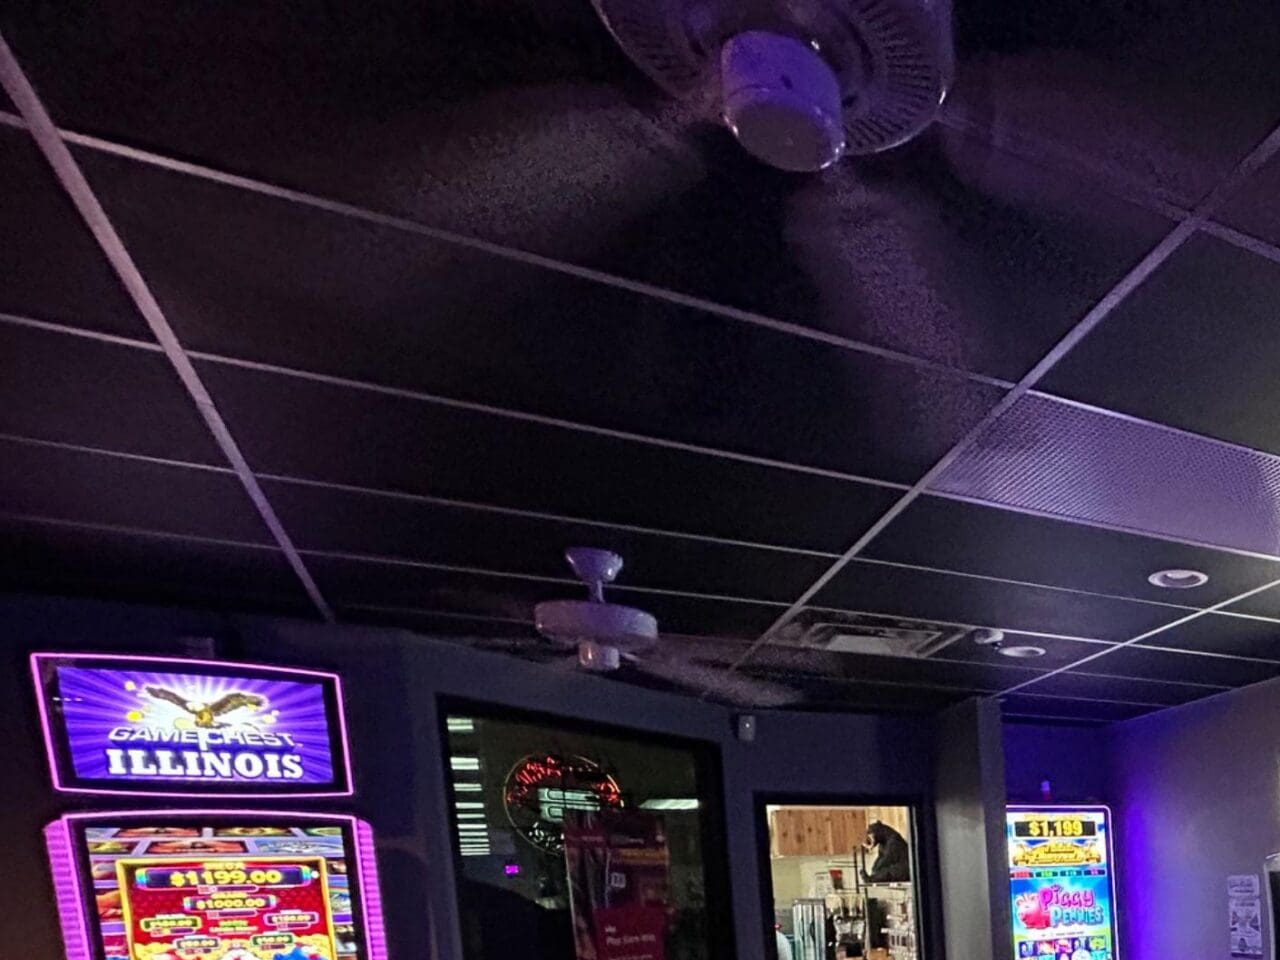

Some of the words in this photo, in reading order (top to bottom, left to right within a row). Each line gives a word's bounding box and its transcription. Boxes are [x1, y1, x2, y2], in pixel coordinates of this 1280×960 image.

[106, 748, 304, 780] ILLINOIS
[1028, 820, 1083, 837] $1,199
[1050, 906, 1104, 928] PENNIES
